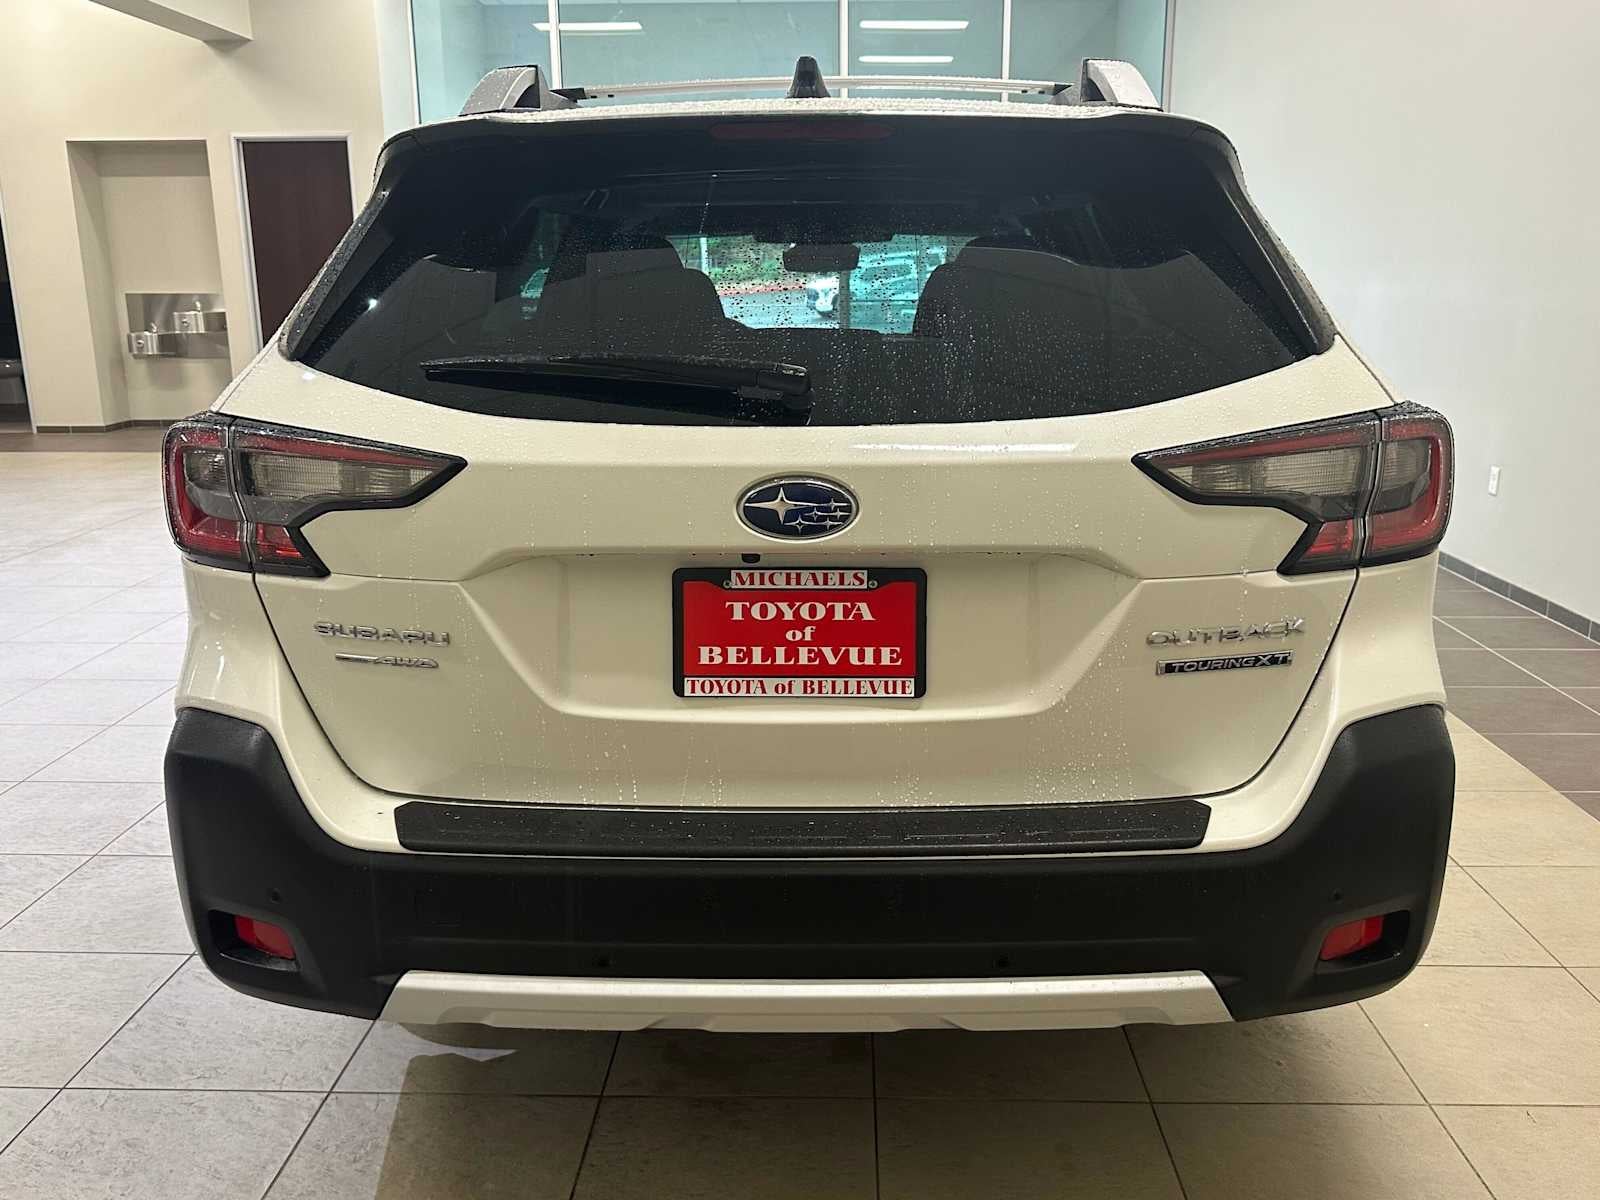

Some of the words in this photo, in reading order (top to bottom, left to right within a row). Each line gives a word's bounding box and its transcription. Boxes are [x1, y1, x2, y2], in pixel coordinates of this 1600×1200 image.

[734, 571, 865, 586] MICHAELS
[725, 601, 876, 621] TOYOTA
[313, 621, 450, 647] SUBARU
[785, 625, 816, 641] of
[1146, 617, 1304, 646] OUTBACK
[698, 646, 902, 666] BELLEVUE
[686, 679, 767, 695] TOYOTA
[774, 679, 796, 695] of
[802, 679, 913, 695] BELLEVUE
